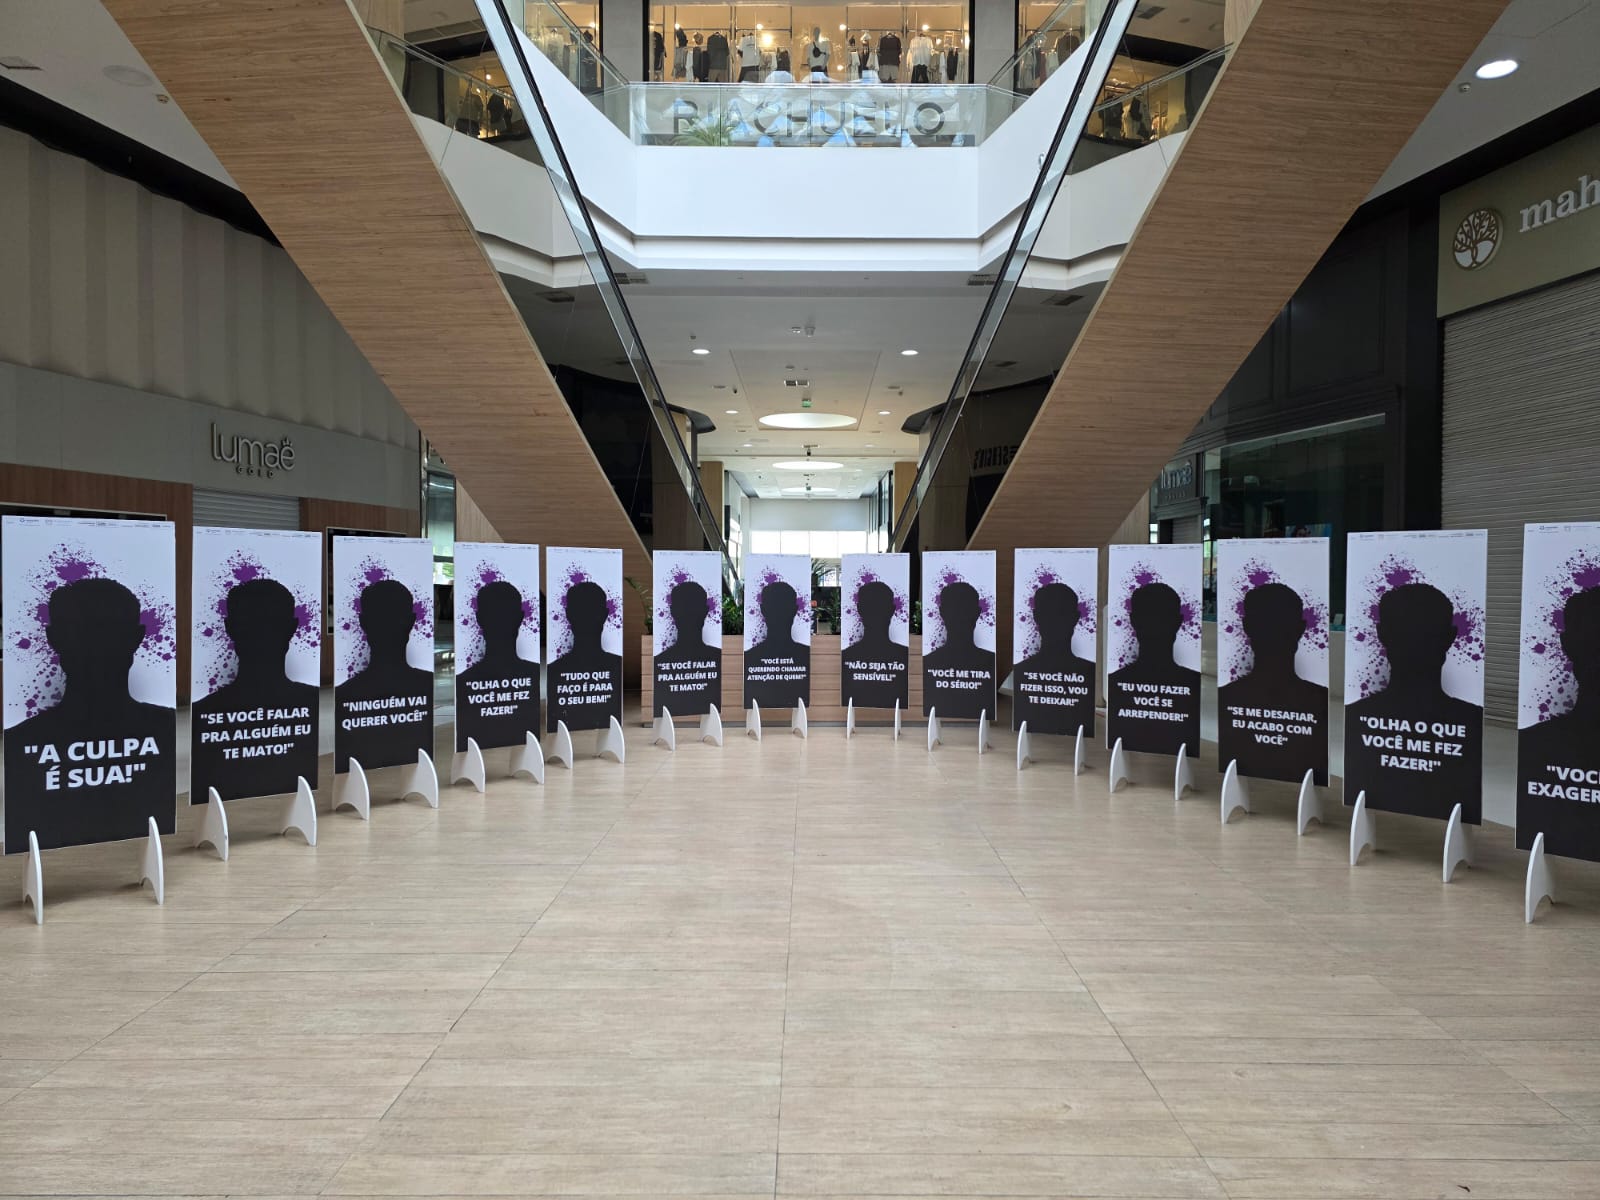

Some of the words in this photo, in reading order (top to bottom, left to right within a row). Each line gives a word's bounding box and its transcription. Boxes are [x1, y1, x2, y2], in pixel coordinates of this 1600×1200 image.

[673, 99, 945, 138] RIACHUELO
[1519, 174, 1600, 233] mah
[671, 661, 691, 669] VOCÊ
[845, 661, 867, 669] "NÃO
[869, 663, 886, 671] SEJA
[888, 662, 904, 670] TÃO
[561, 672, 590, 680] "TUDO
[592, 671, 609, 681] QUE
[675, 671, 706, 680] ALGUÉM
[853, 672, 896, 681] SENSÍVEL!"
[928, 668, 954, 677] "VOCÊ
[956, 670, 968, 678] ME
[1024, 672, 1037, 680] "SE
[1039, 673, 1062, 681] VOCÊ
[1064, 673, 1084, 682] NÃO
[466, 680, 499, 690] "OLHA
[501, 679, 509, 688] O
[511, 678, 531, 688] QUE
[557, 685, 581, 694] FAÇO
[583, 682, 587, 692] É
[590, 683, 613, 691] PARA
[680, 683, 707, 691] MATO!"
[951, 680, 982, 689] SÉRIO!"
[1021, 684, 1042, 692] FIZER
[1045, 685, 1066, 694] ISSO,
[1118, 683, 1134, 691] "EU
[1136, 684, 1158, 693] VOU
[1160, 686, 1190, 695] FAZER
[343, 696, 405, 711] "NINGUÉM
[408, 696, 426, 706] VAI
[468, 692, 494, 704] VOCÊ
[497, 693, 511, 701] ME
[514, 691, 529, 700] FEZ
[568, 696, 584, 704] SEU
[586, 695, 611, 703] BEM!"
[1040, 697, 1078, 706] DEIXAR!"
[1134, 697, 1159, 706] VOCÊ
[1162, 699, 1172, 707] SE
[201, 712, 224, 725] "SE
[227, 708, 264, 723] VOCÊ
[267, 708, 309, 720] FALAR
[481, 705, 518, 716] FAZER!"
[1118, 709, 1188, 721] ARREPENDER!"
[1246, 708, 1261, 717] ME
[1264, 710, 1317, 723] DESAFIAR,
[342, 715, 388, 730] QUERER
[390, 710, 427, 723] VOCÊ!"
[1233, 720, 1245, 728] EU
[1247, 721, 1284, 732] ACABO
[1287, 725, 1311, 735] COM
[1359, 716, 1412, 733] "OLHA
[1415, 722, 1427, 733] O
[1432, 723, 1465, 737] QUE
[202, 731, 230, 743] PRA
[233, 724, 291, 740] ALGUÉM
[295, 725, 310, 735] EU
[25, 744, 60, 763] "A
[68, 737, 159, 761] CULPA
[223, 748, 239, 759] TE
[243, 743, 294, 757] MATO!"
[1362, 735, 1402, 749] VOCÊ
[1407, 739, 1430, 752] ME
[1435, 742, 1462, 756] FEZ
[1381, 755, 1440, 771] FAZER!"
[46, 766, 60, 790] É
[68, 763, 145, 787] SUA!"
[1546, 764, 1600, 785] "VOC
